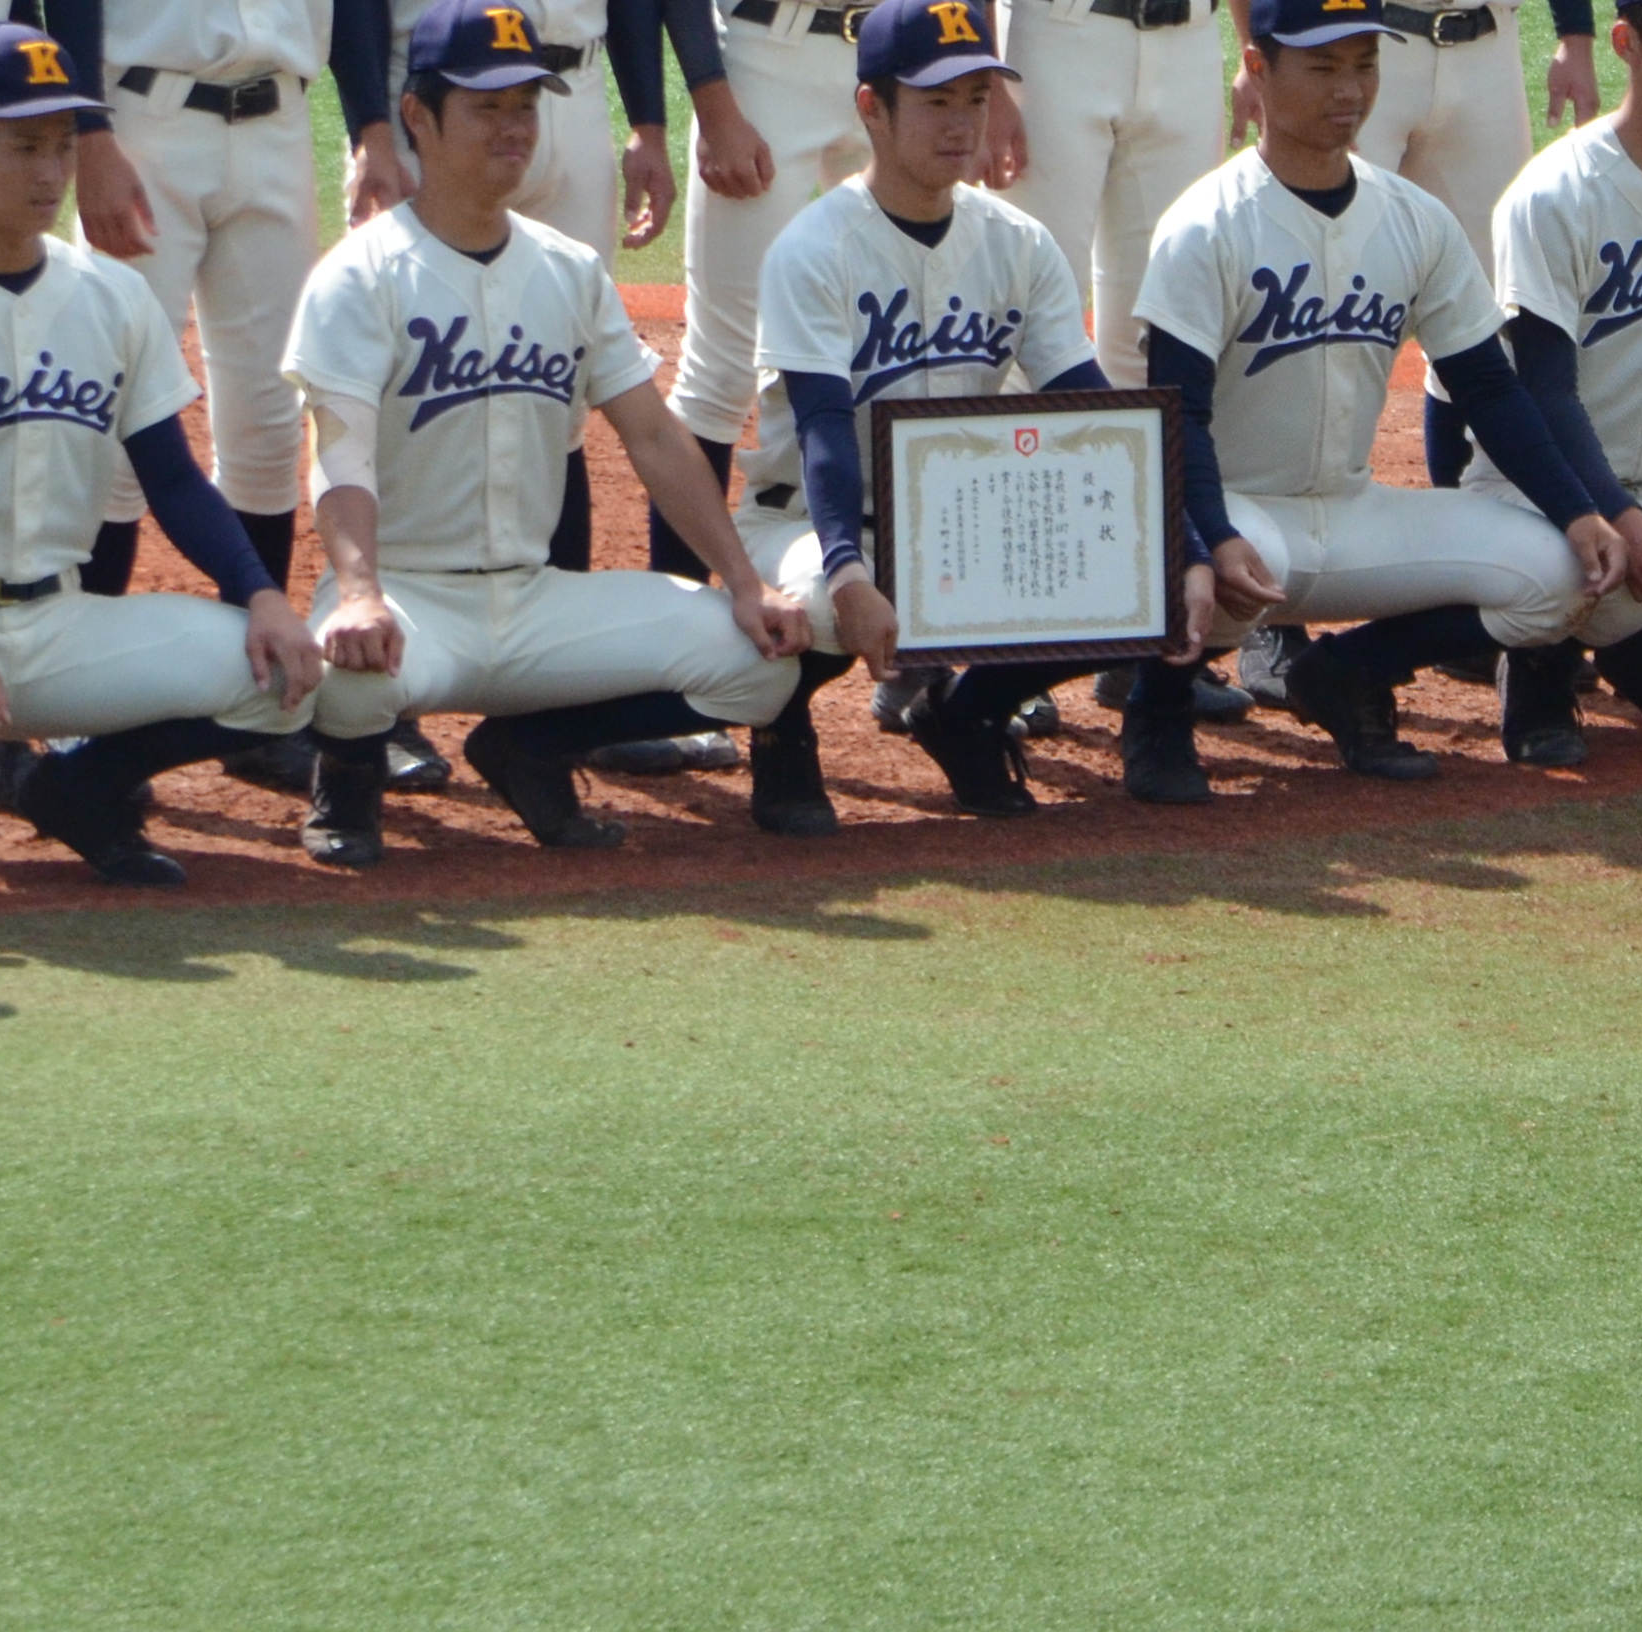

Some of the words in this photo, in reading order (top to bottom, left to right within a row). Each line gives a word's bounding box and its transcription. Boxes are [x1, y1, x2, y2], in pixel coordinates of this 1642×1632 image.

[484, 7, 533, 53] K
[927, 0, 981, 45] K
[17, 41, 70, 85] K
[398, 315, 584, 432] Kaisei
